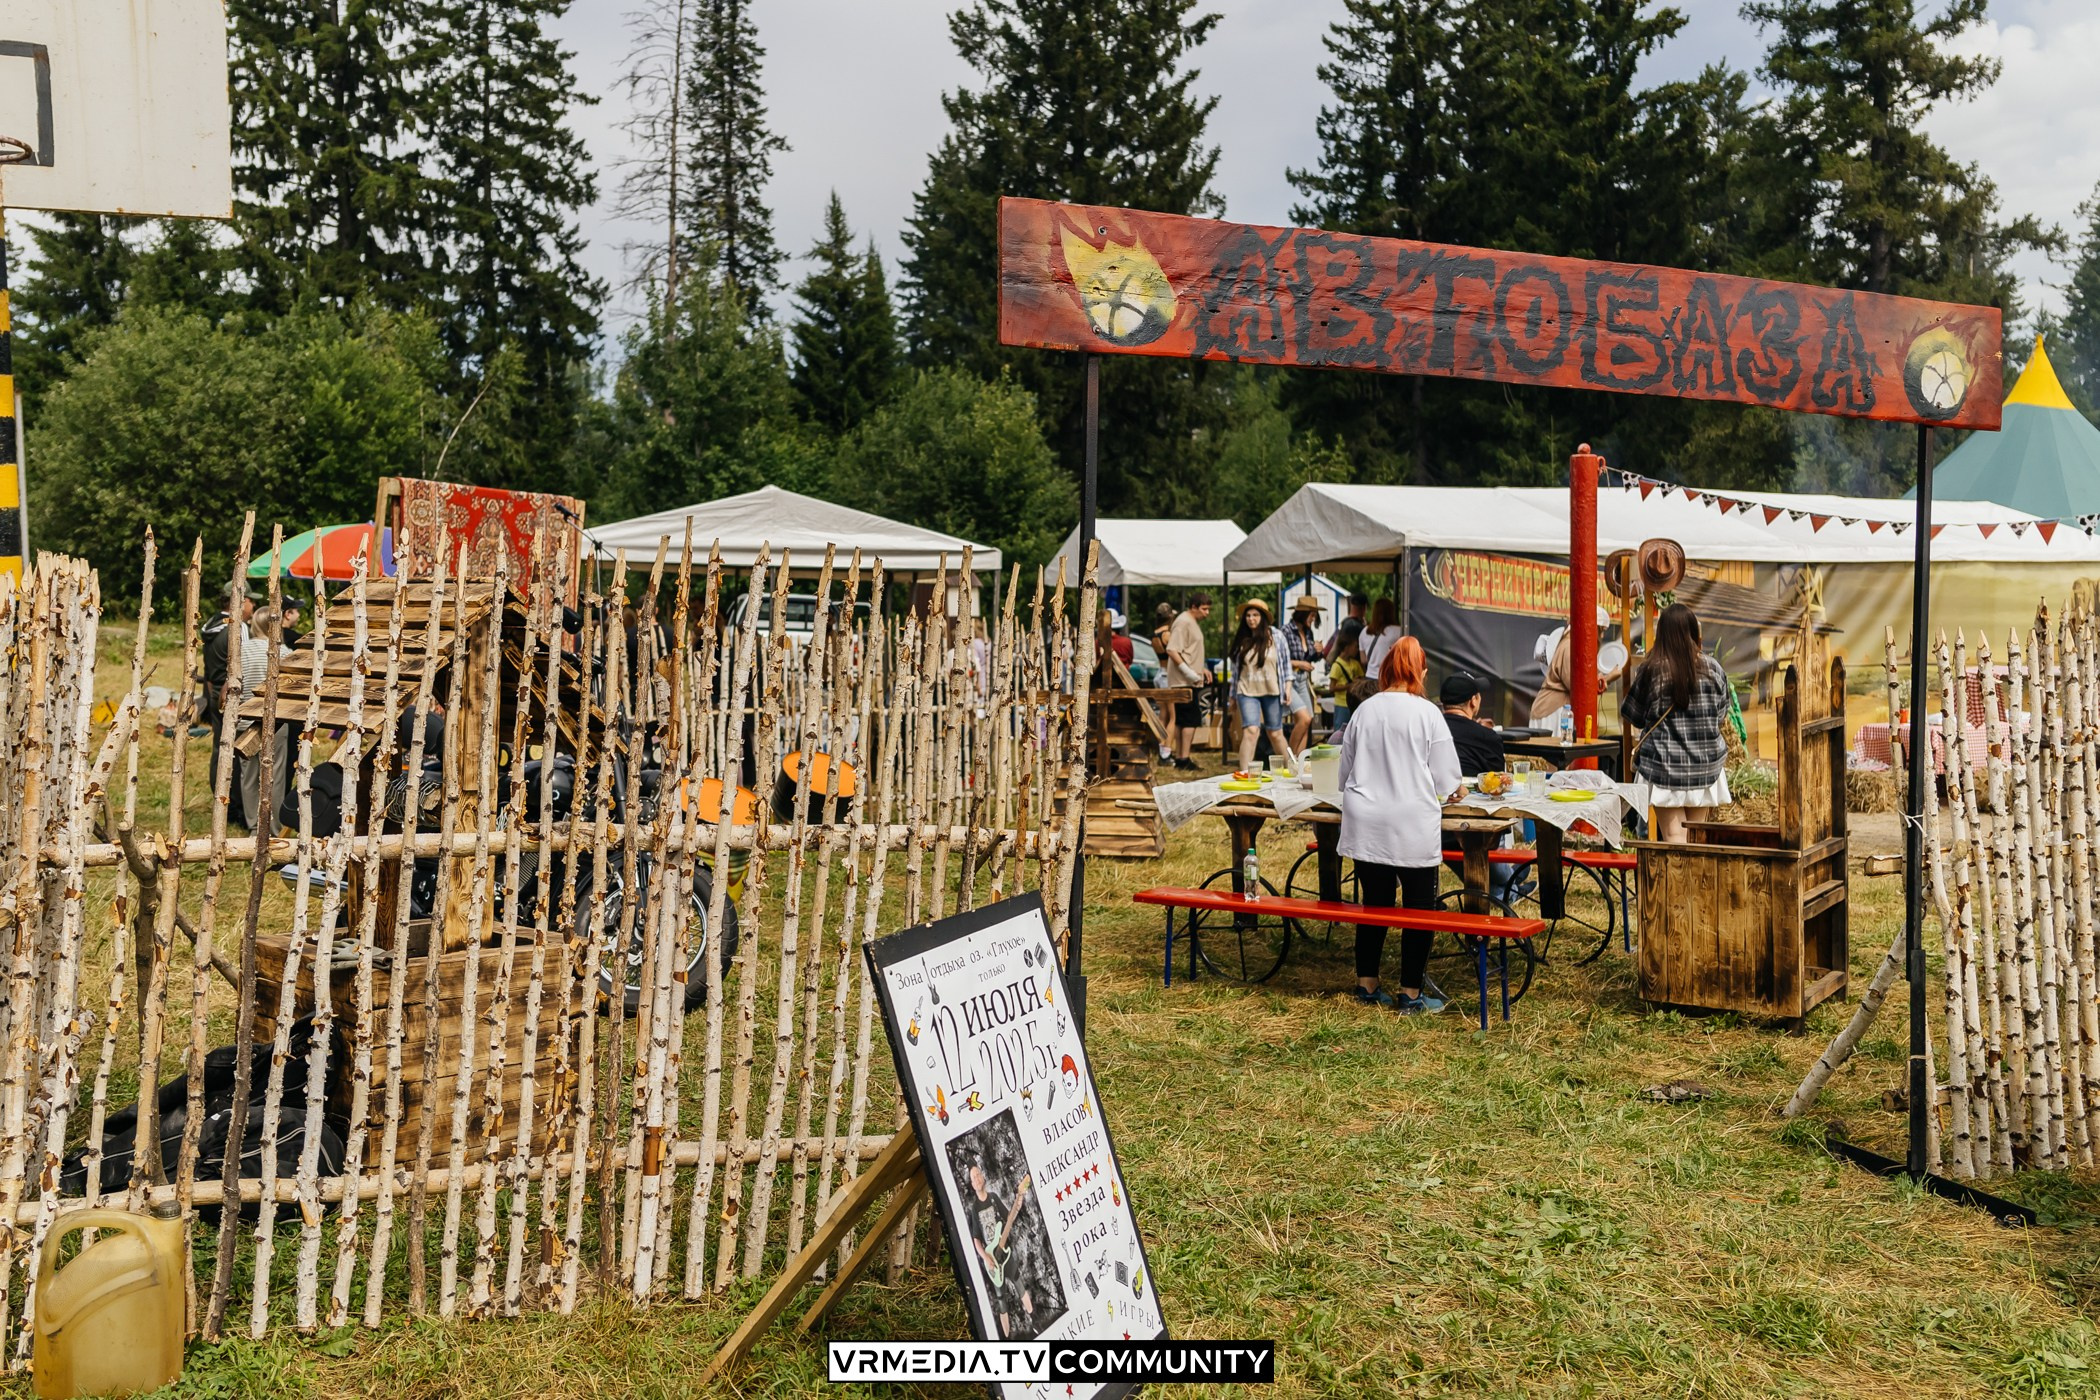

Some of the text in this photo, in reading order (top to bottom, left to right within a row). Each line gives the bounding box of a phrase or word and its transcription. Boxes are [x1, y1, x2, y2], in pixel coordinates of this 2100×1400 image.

[1191, 226, 1884, 412] АВТОБАЗА
[1454, 552, 1571, 610] ЧЕРНИГОВСКИ
[896, 935, 1026, 990] Зона отдыха оз. «Глухое»
[978, 964, 1006, 983] только
[930, 975, 1043, 1097] 12 ИЮЛЯ
[1042, 1103, 1087, 1145] ВЛАСОВ
[1038, 1130, 1099, 1188] АЛЕКСАНДР
[1058, 1186, 1106, 1232] Звезда
[1073, 1221, 1107, 1263] рока
[1119, 1300, 1154, 1329] ИГРЫ
